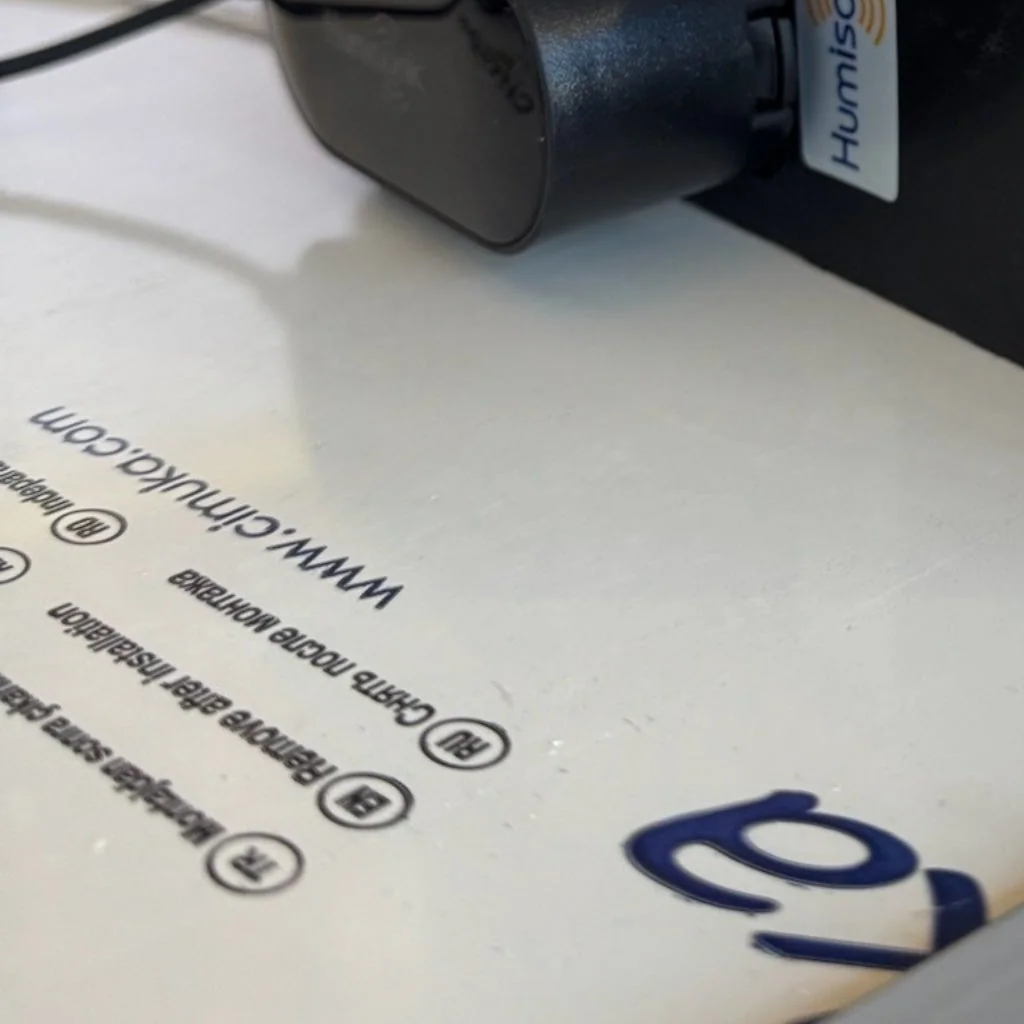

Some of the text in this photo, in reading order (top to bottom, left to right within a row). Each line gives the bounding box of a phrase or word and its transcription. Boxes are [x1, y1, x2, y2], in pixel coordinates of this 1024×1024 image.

[29, 406, 404, 610] www.cimuka.com
[168, 569, 281, 624] монтажа
[268, 627, 357, 677] после
[159, 676, 233, 716] after
[350, 671, 436, 727] Снять
[219, 710, 338, 786] Remove
